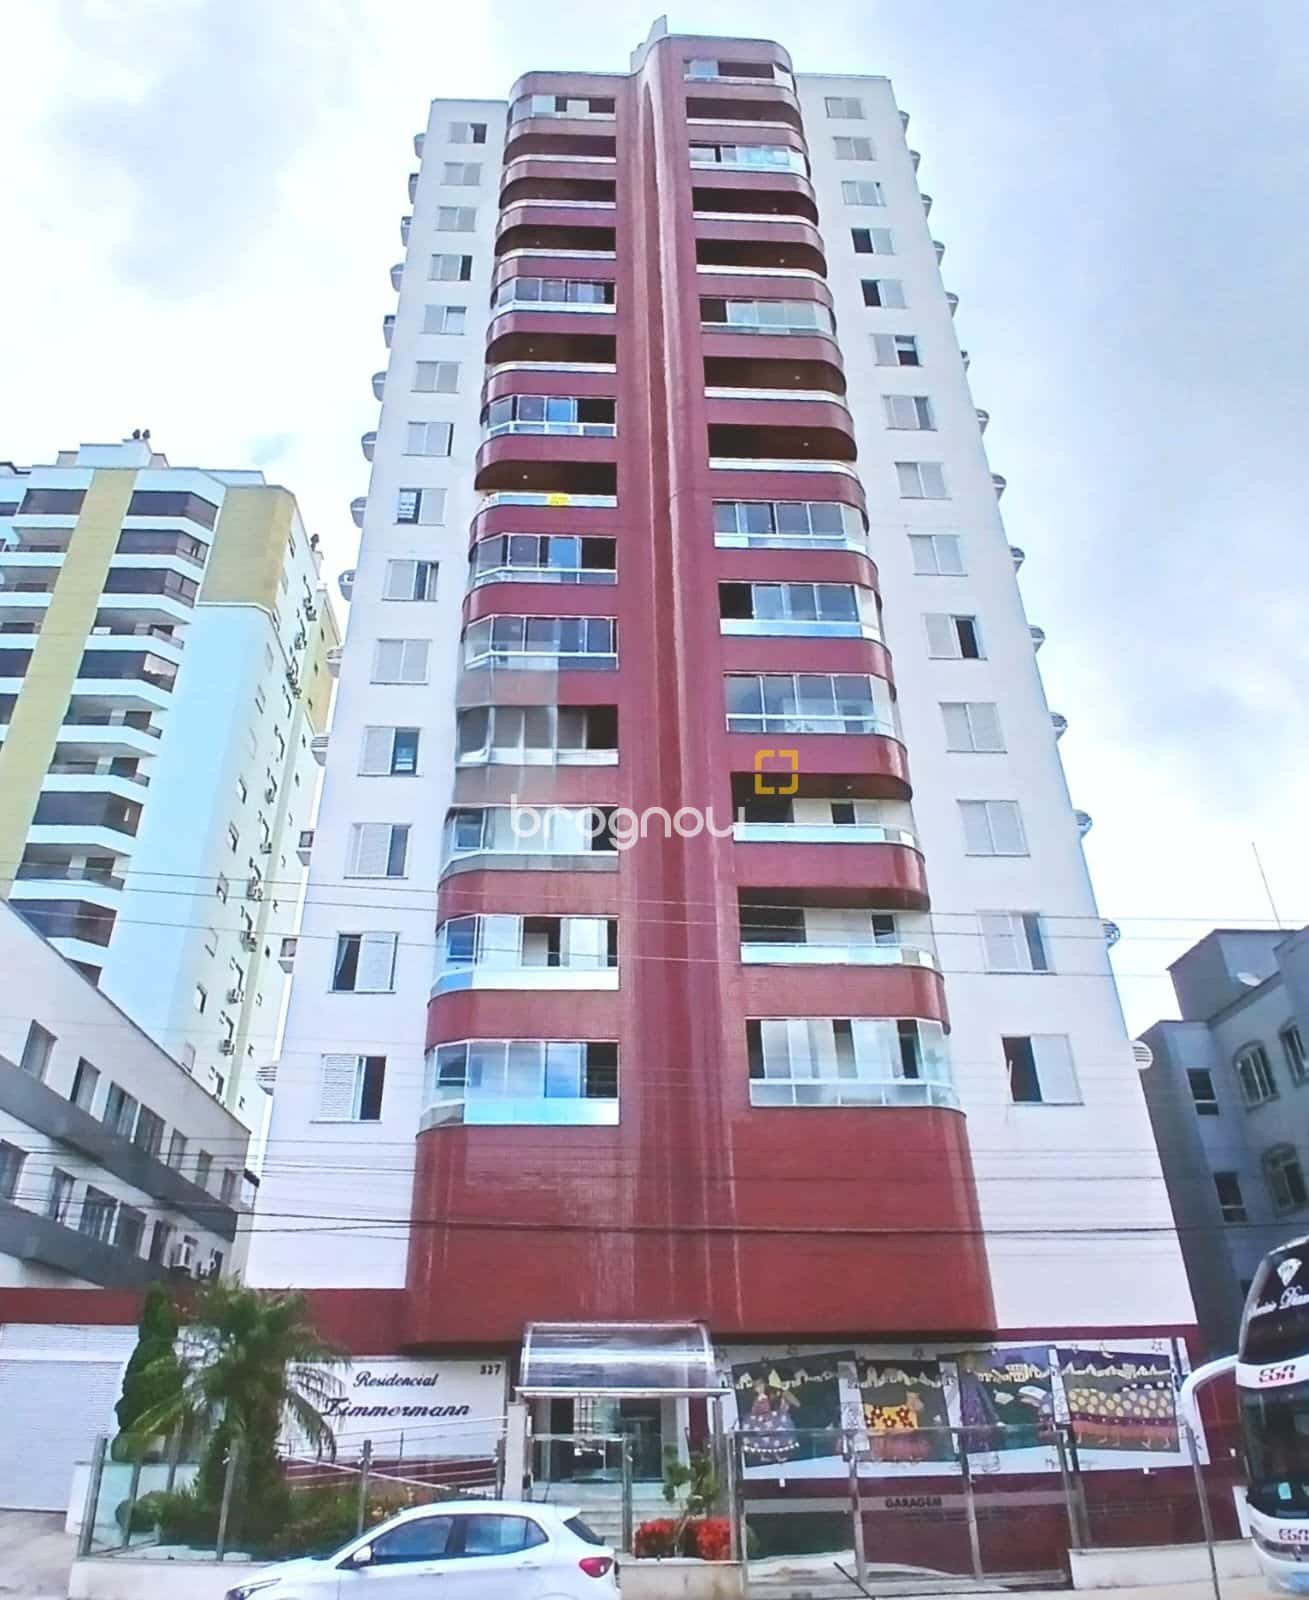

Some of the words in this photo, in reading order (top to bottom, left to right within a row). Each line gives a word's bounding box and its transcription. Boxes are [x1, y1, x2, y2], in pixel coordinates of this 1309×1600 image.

[353, 1371, 439, 1387] Residencial
[323, 1397, 470, 1417] Zimmermann
[885, 1496, 942, 1508] GARAGEM
